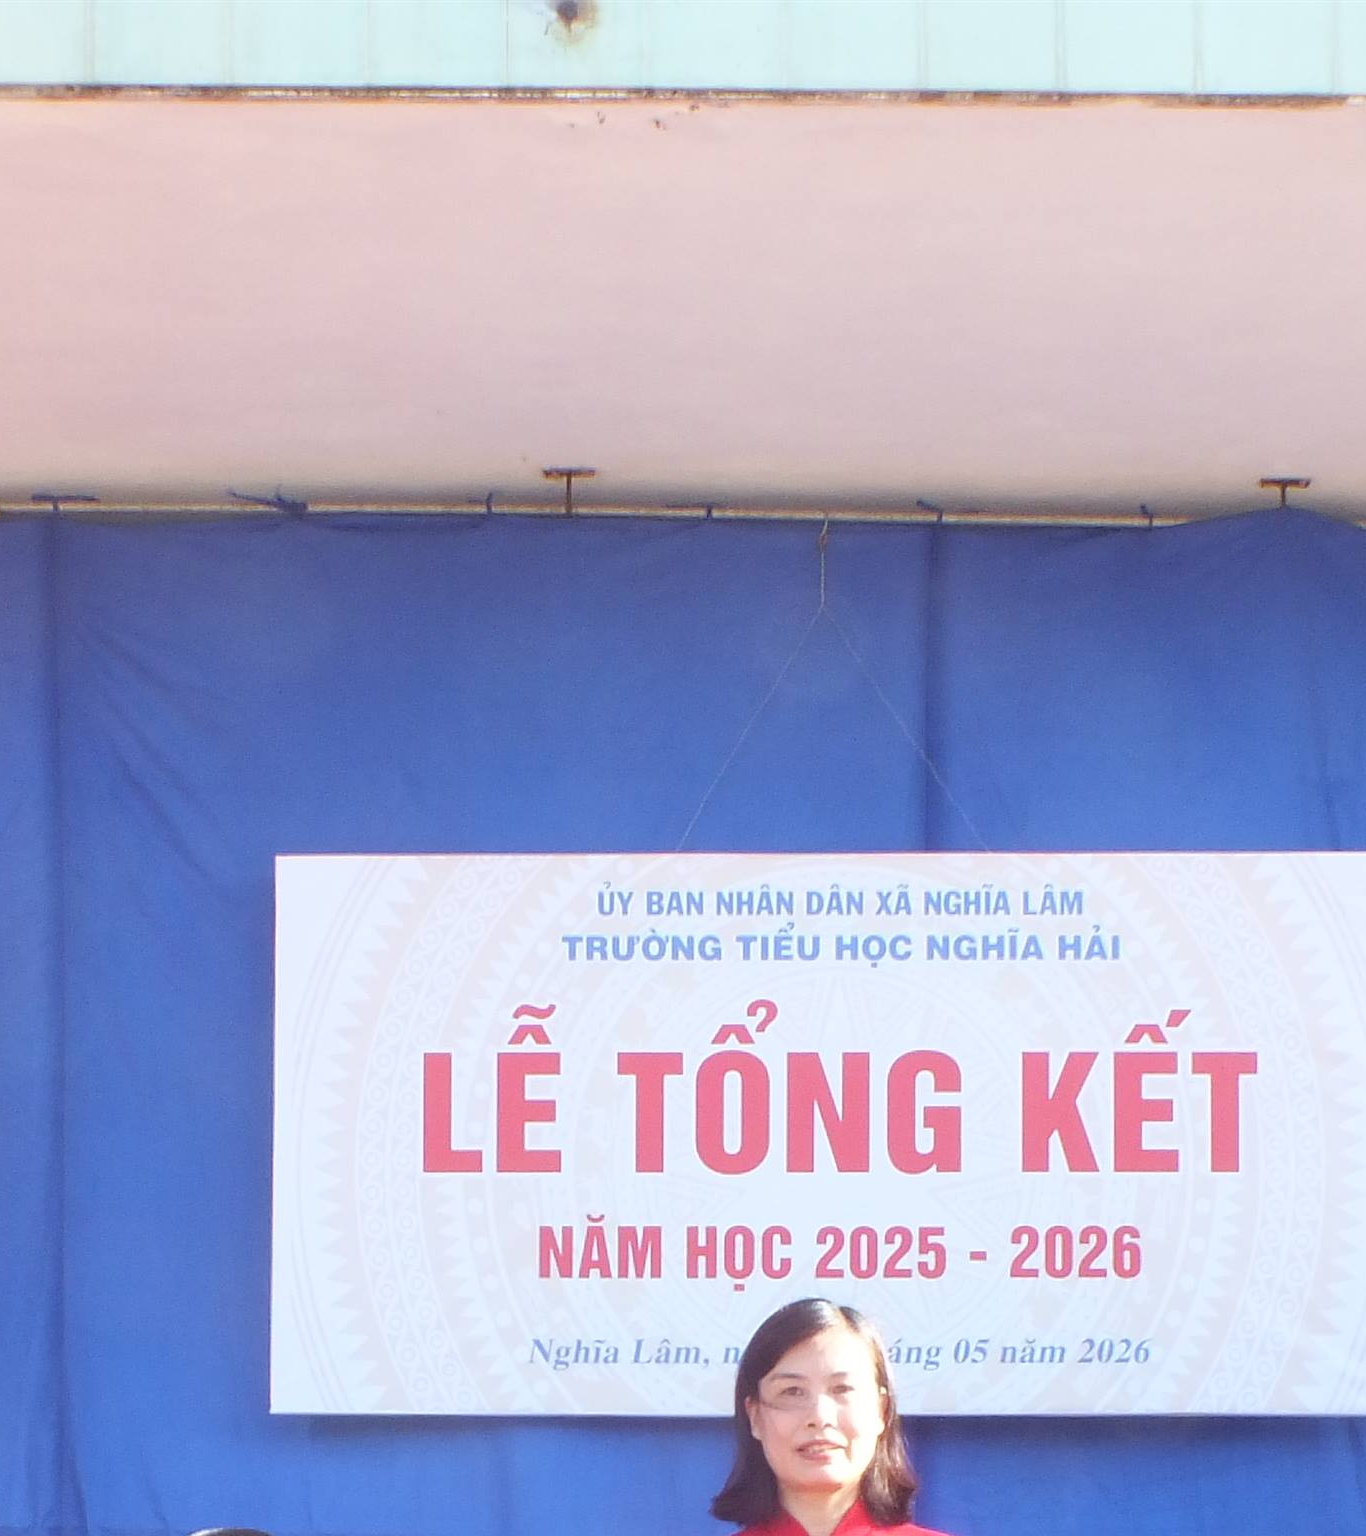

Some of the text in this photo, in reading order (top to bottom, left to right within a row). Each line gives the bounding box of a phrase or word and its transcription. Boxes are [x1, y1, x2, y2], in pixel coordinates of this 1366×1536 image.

[597, 881, 1084, 916] ỦY BAN NHÂN DÂN XÃ NGHĨA LÂM
[561, 921, 1121, 968] TRƯỜNG TIỂU HỌC NGHĨA HẢI
[422, 999, 1258, 1175] LỄ TỔNG KẾT
[538, 1214, 662, 1279] NĂM
[686, 1225, 792, 1292] HỌC
[815, 1225, 947, 1279] 2025
[1009, 1225, 1142, 1279] 2026
[529, 1338, 619, 1371] Nghĩa
[632, 1338, 710, 1366] Lâm,
[888, 1338, 943, 1371] áng
[953, 1338, 990, 1364] 05
[999, 1338, 1067, 1364] năm
[1077, 1337, 1151, 1364] 2026
